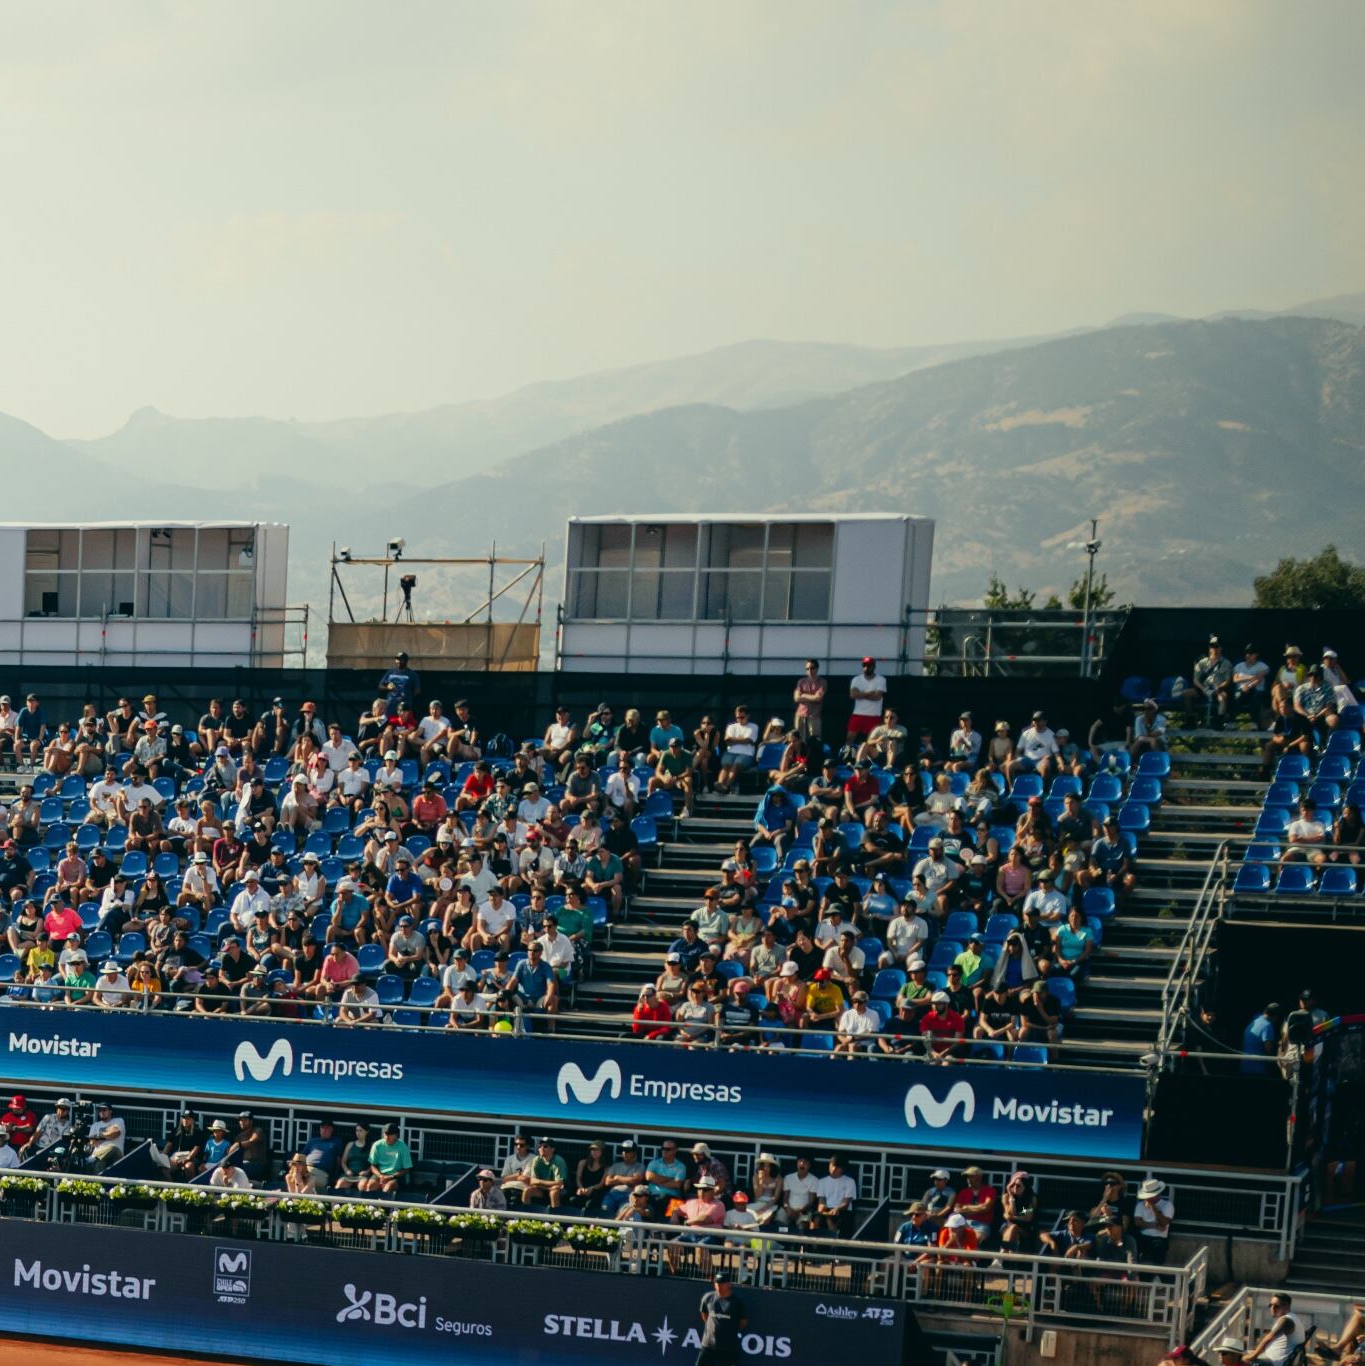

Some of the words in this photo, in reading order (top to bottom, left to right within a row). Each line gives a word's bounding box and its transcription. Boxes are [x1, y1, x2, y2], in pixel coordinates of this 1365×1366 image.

[8, 1032, 102, 1058] Movistar
[300, 1052, 404, 1081] Empresas
[629, 1074, 742, 1105] Empresas
[992, 1097, 1114, 1127] Movistar
[13, 1258, 156, 1300] Movistar
[374, 1293, 427, 1329] Bci
[435, 1316, 493, 1336] Seguros
[862, 1307, 894, 1319] ATP
[543, 1314, 647, 1344] STELLA
[681, 1327, 791, 1357] AOIS
